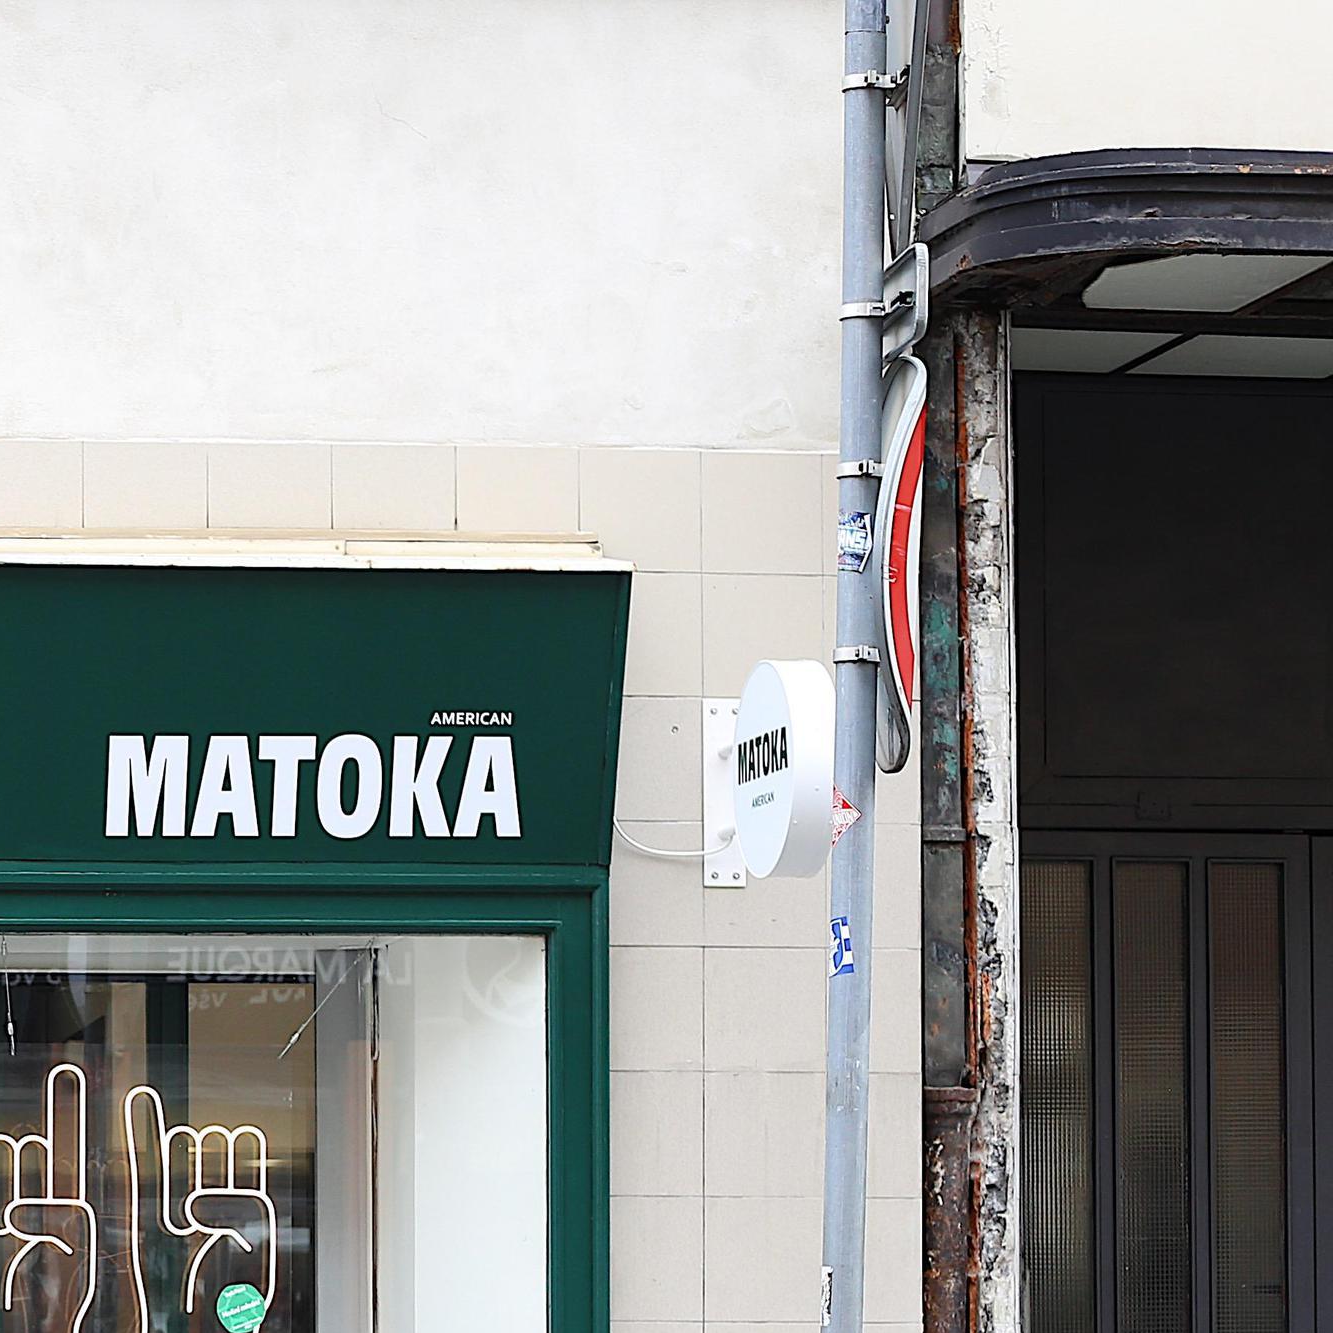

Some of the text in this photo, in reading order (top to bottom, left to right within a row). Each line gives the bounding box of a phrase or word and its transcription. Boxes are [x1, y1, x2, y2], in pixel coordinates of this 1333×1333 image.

[430, 711, 512, 727] AMERICAN
[104, 733, 522, 839] MATOKA
[737, 726, 789, 786] MATOKA
